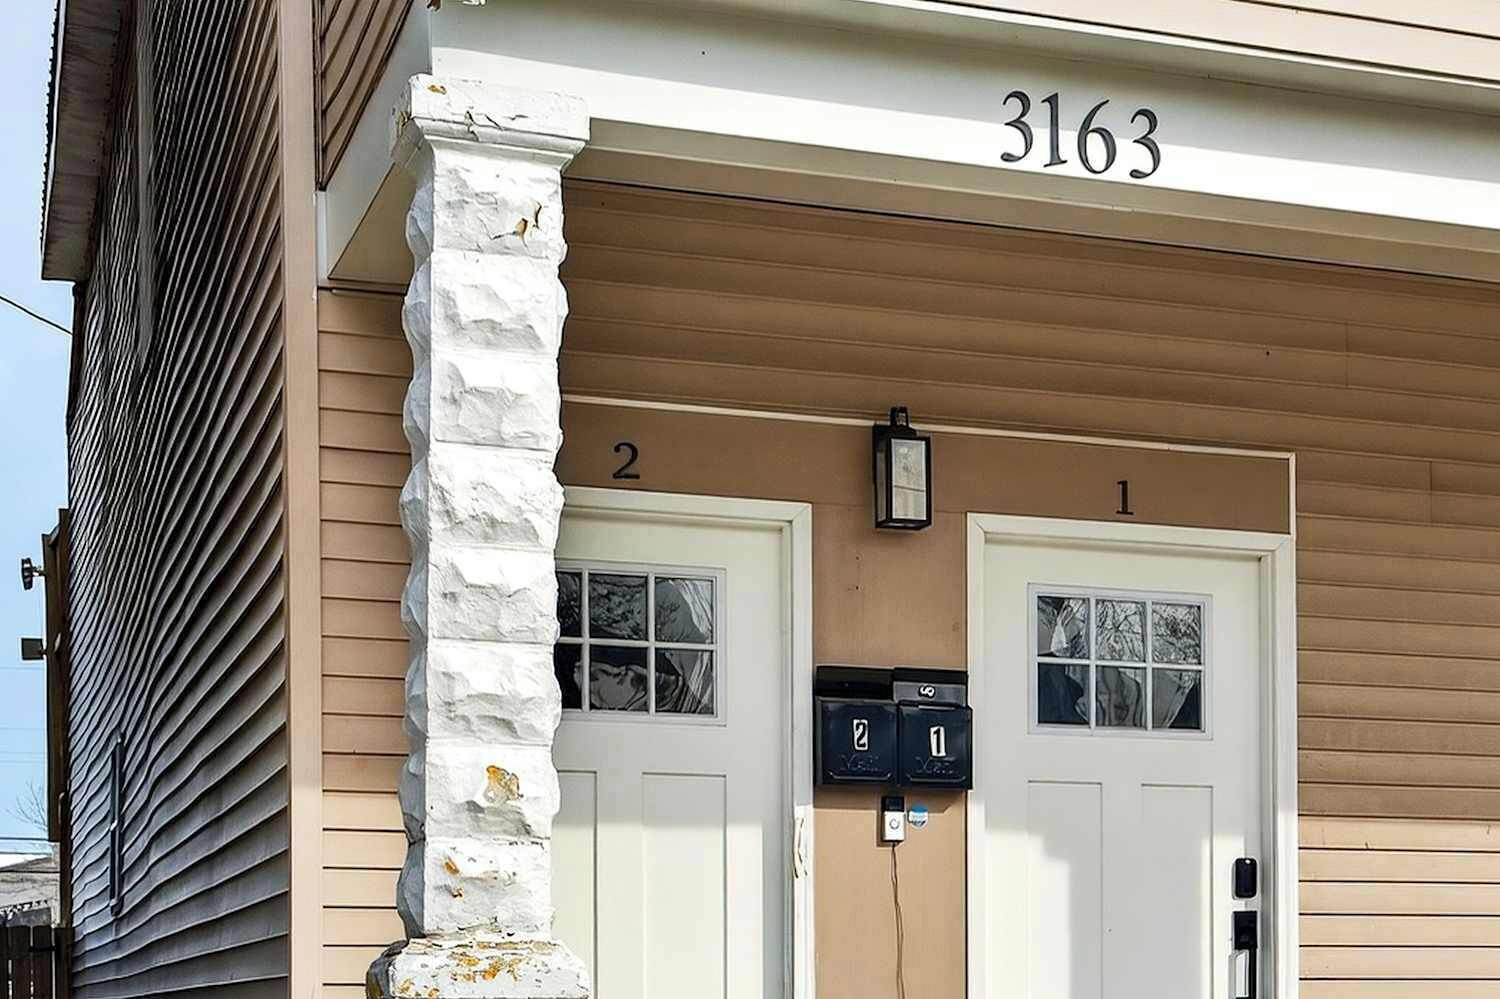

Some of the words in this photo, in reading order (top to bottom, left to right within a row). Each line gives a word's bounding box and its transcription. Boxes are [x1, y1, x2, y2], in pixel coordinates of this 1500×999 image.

[1000, 90, 1161, 179] 3163
[613, 442, 640, 480] 2
[1116, 480, 1134, 515] 1
[855, 721, 867, 749] 2
[932, 727, 944, 755] 1
